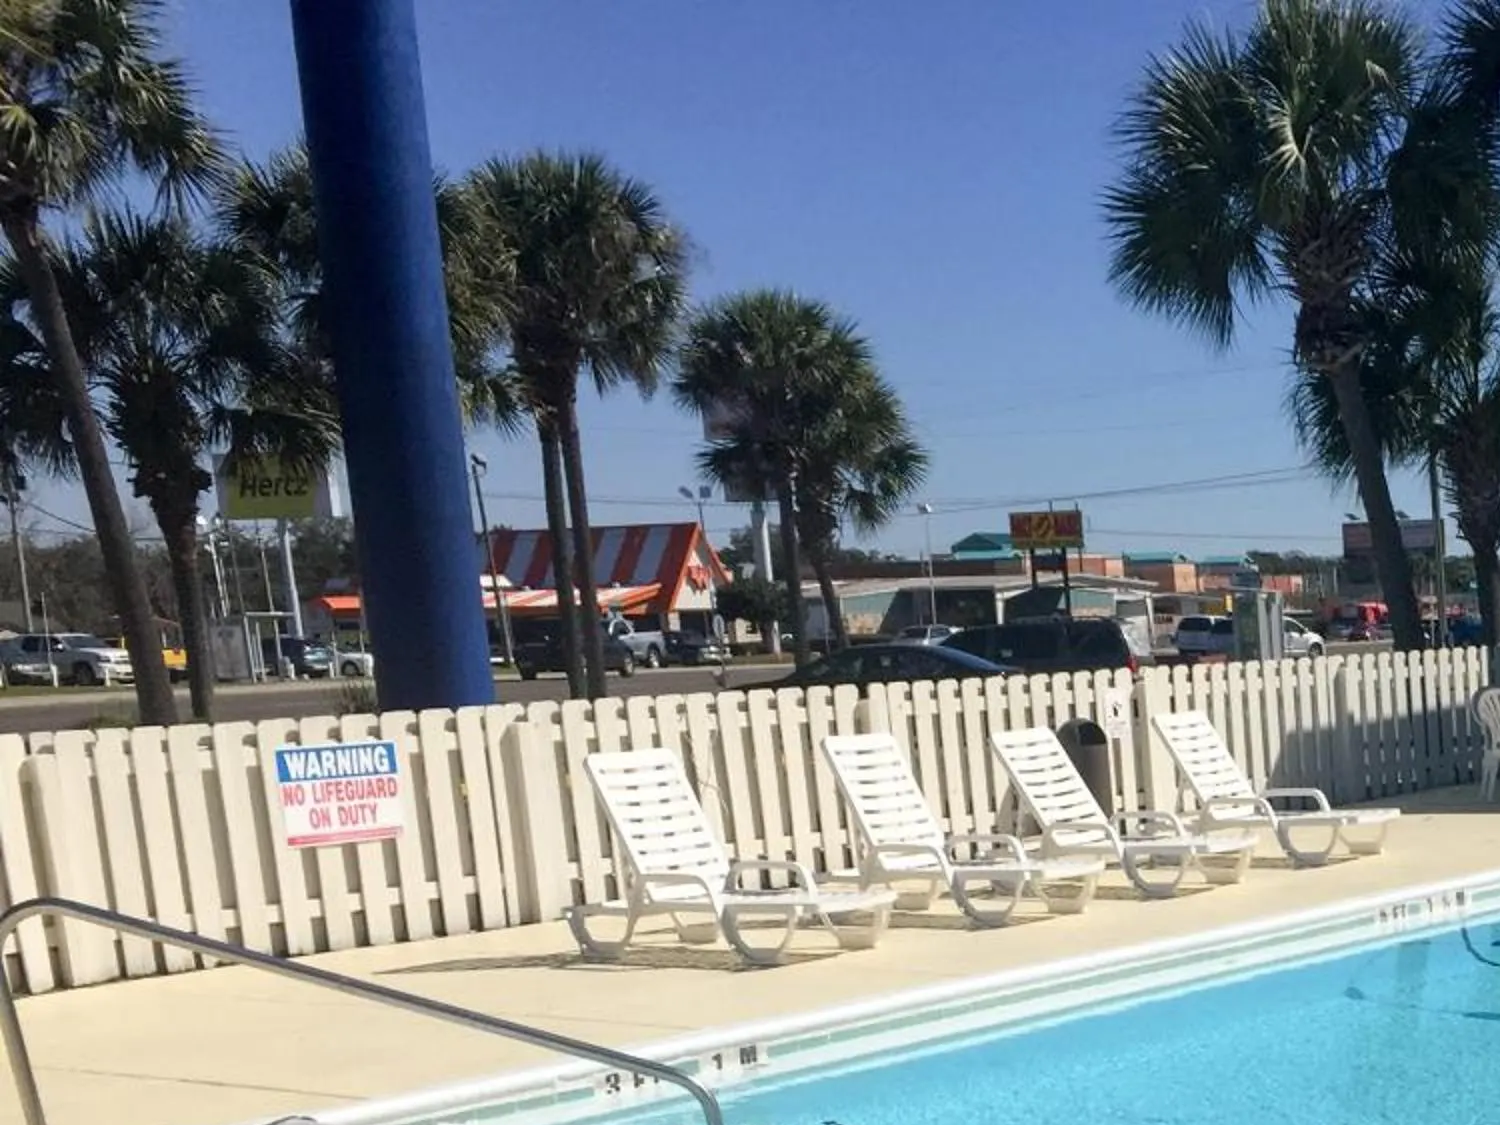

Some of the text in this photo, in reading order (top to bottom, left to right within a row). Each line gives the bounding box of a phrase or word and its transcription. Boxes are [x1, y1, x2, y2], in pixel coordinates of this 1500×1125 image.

[240, 473, 308, 498] Hertz
[283, 746, 390, 779] WARNING
[282, 777, 398, 806] NO LIFEGUARD
[309, 802, 378, 829] ON DUTY
